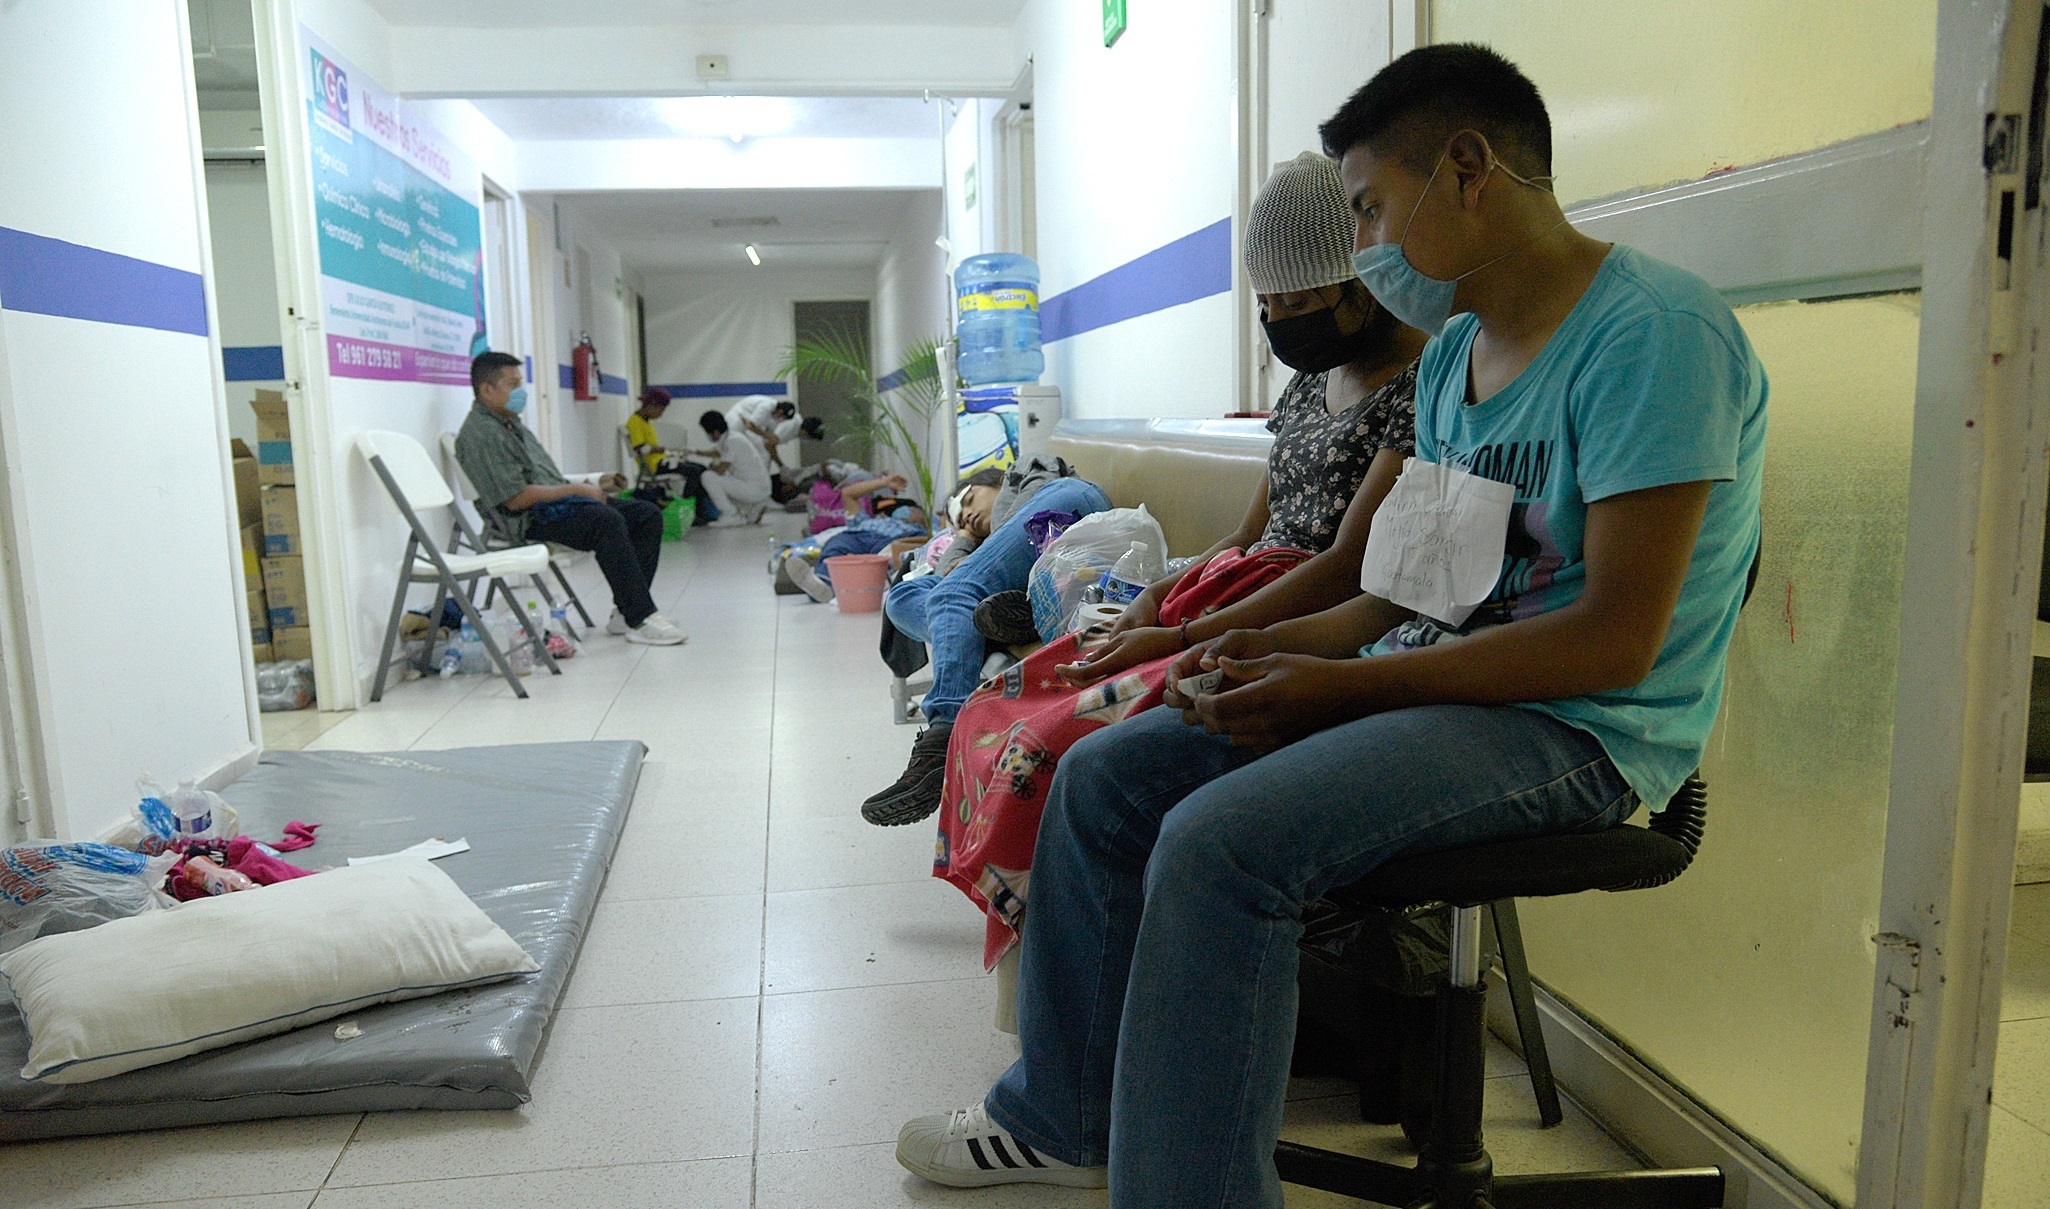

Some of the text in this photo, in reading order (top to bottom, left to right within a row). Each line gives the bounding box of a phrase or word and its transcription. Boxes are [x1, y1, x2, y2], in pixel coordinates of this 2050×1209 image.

[313, 57, 348, 111] KGC
[363, 90, 410, 152] Nuestos
[411, 127, 451, 180] Servicios
[336, 341, 350, 364] Tel
